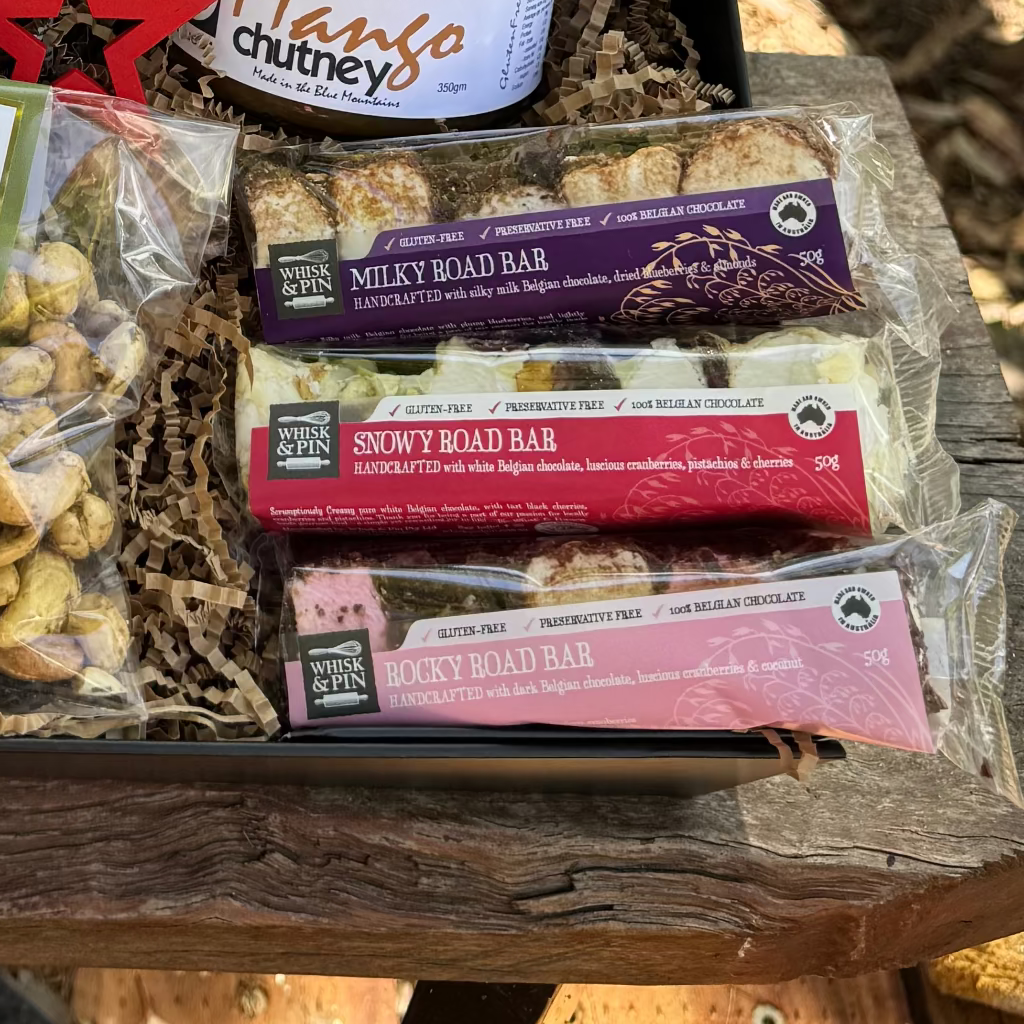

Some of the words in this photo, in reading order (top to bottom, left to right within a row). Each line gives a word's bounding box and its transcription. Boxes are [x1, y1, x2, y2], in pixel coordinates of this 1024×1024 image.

[233, 22, 393, 97] chutney
[253, 66, 277, 85] Made
[280, 78, 293, 89] in
[295, 82, 311, 94] the
[314, 85, 338, 100] Blue
[341, 91, 400, 109] Mountains
[437, 82, 467, 95] 350gm
[639, 206, 685, 220] BELGIAN
[686, 199, 746, 215] CHOCOLATE
[495, 219, 563, 236] PRESERVATIVE
[565, 216, 591, 229] FREE
[399, 231, 465, 247] GLUTEN-FREE
[799, 248, 825, 266] 50g
[279, 263, 331, 280] WHISK
[349, 260, 426, 291] MILKY
[430, 252, 495, 283] ROAD
[498, 247, 549, 275] BAR
[354, 288, 442, 310] HANDCRAFTED
[444, 285, 468, 300] with
[469, 281, 494, 299] silky
[496, 280, 520, 294] milk
[522, 278, 561, 295] Belgian
[563, 273, 612, 288] chocolate,
[613, 268, 641, 283] dried
[641, 263, 699, 279] blueberries
[700, 261, 711, 273] &
[713, 256, 757, 271] almonds
[405, 403, 473, 414] GLUTEN-FREE
[505, 400, 576, 412] PRESERVATIVE
[578, 400, 604, 410] FREE
[656, 399, 702, 409] BELGIAN
[704, 398, 764, 408] CHOCOLATE
[278, 426, 330, 440] WHISK
[353, 429, 434, 455] SNOWY
[439, 428, 503, 454] ROAD
[507, 427, 557, 452] BAR
[354, 459, 441, 474] HANDCRAFTED
[444, 459, 465, 473] with
[468, 459, 494, 472] white
[497, 459, 534, 476] Belgian
[537, 458, 584, 472] chocolate,
[586, 458, 624, 470] luscious
[627, 457, 686, 471] cranberries,
[688, 456, 738, 472] pistachios
[741, 458, 751, 469] &
[753, 455, 794, 468] cherries
[815, 455, 839, 471] 50g
[694, 598, 741, 613] BELGIAN
[744, 591, 805, 607] CHOCOLATE
[539, 612, 613, 628] PRESERVATIVE
[616, 609, 642, 621] FREE
[438, 623, 506, 639] GLUTEN-FREE
[310, 658, 365, 674] WHISK
[384, 654, 462, 688] ROCKY
[468, 647, 536, 679] ROAD
[540, 642, 594, 671] BAR
[864, 648, 891, 667] 50g
[390, 686, 483, 708] HANDCRAFTED
[487, 683, 510, 698] with
[513, 681, 538, 696] dark
[541, 679, 581, 695] Belgian
[584, 674, 635, 689] chocolate,
[638, 669, 680, 684] luscious
[683, 662, 744, 678] cranberries
[748, 661, 759, 672] &
[761, 656, 804, 672] coconut
